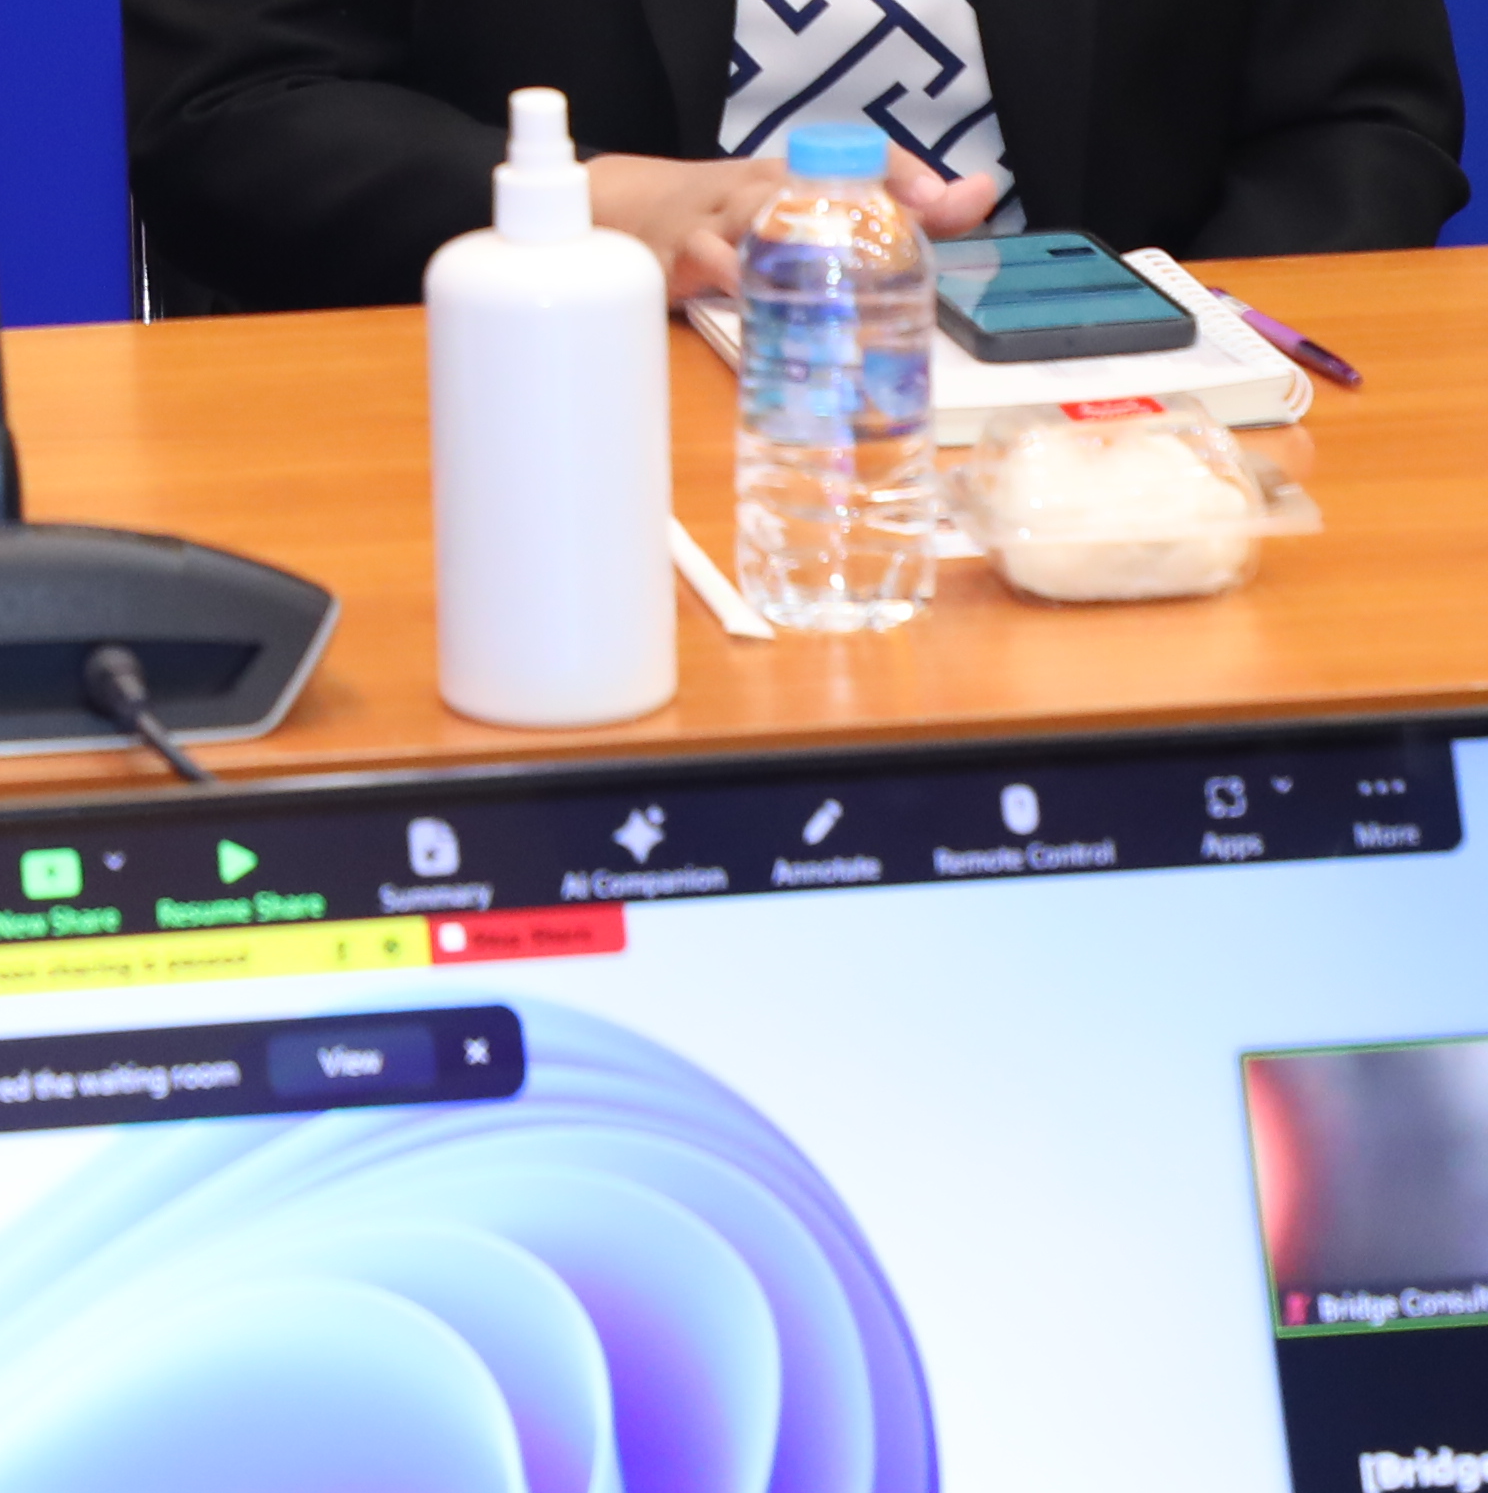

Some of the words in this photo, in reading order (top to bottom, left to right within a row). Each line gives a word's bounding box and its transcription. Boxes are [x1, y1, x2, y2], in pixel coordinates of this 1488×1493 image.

[933, 844, 1024, 876] Remote
[1025, 837, 1117, 870] Control
[1200, 830, 1265, 861] Apps
[561, 871, 590, 901] AI
[591, 864, 729, 900] Companion
[771, 855, 883, 888] Annotate
[155, 896, 253, 929] Resume
[253, 890, 326, 922] Share
[378, 882, 494, 913] Summary
[48, 904, 122, 937] Share
[317, 1046, 384, 1079] View
[33, 1067, 76, 1102] the
[76, 1060, 171, 1100] waiting
[171, 1060, 241, 1091] room
[1317, 1290, 1399, 1326] Bridge
